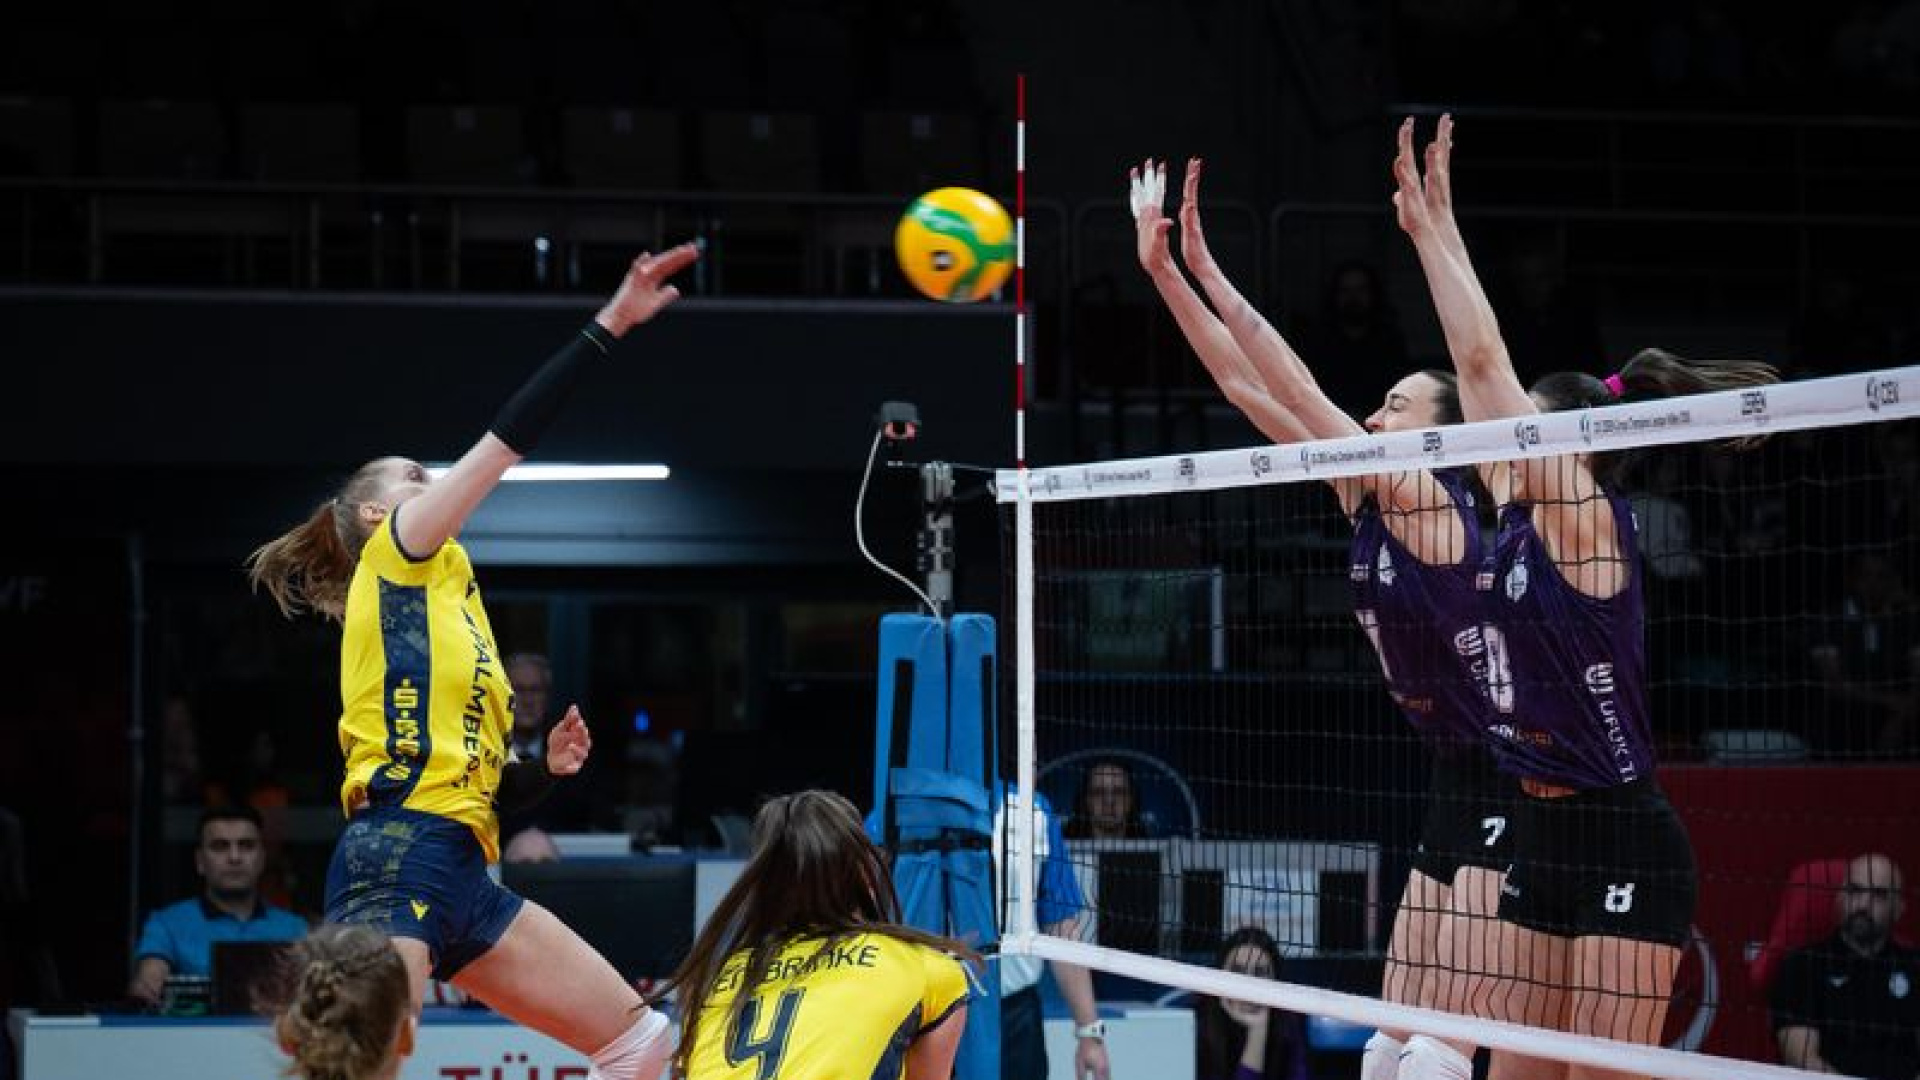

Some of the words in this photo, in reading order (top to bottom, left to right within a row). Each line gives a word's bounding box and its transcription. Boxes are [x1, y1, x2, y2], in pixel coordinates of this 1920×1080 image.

[1481, 815, 1506, 846] 7
[1604, 882, 1636, 913] 8
[726, 987, 807, 1080] 4
